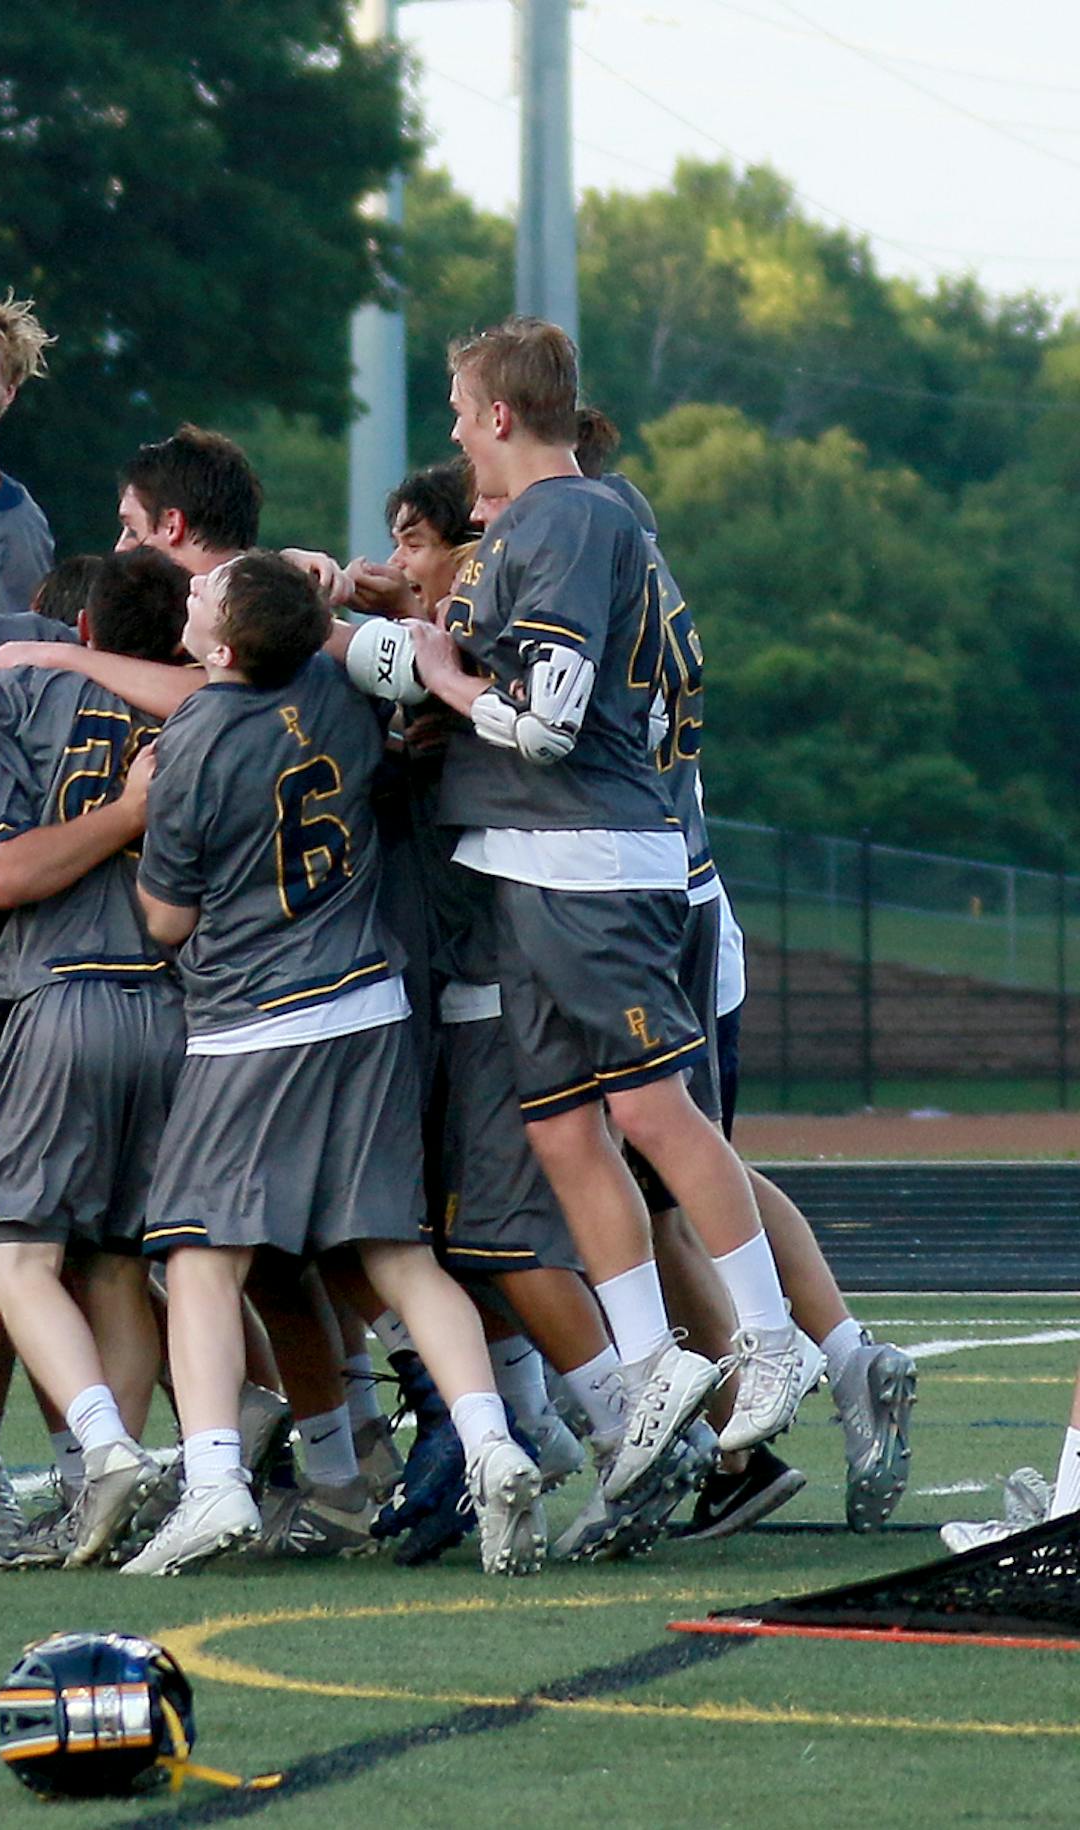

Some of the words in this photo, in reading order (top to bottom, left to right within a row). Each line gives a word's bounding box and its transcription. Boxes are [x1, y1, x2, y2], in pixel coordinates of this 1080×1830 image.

[377, 637, 396, 684] STX
[275, 754, 353, 919] 6
[625, 1006, 661, 1048] PL
